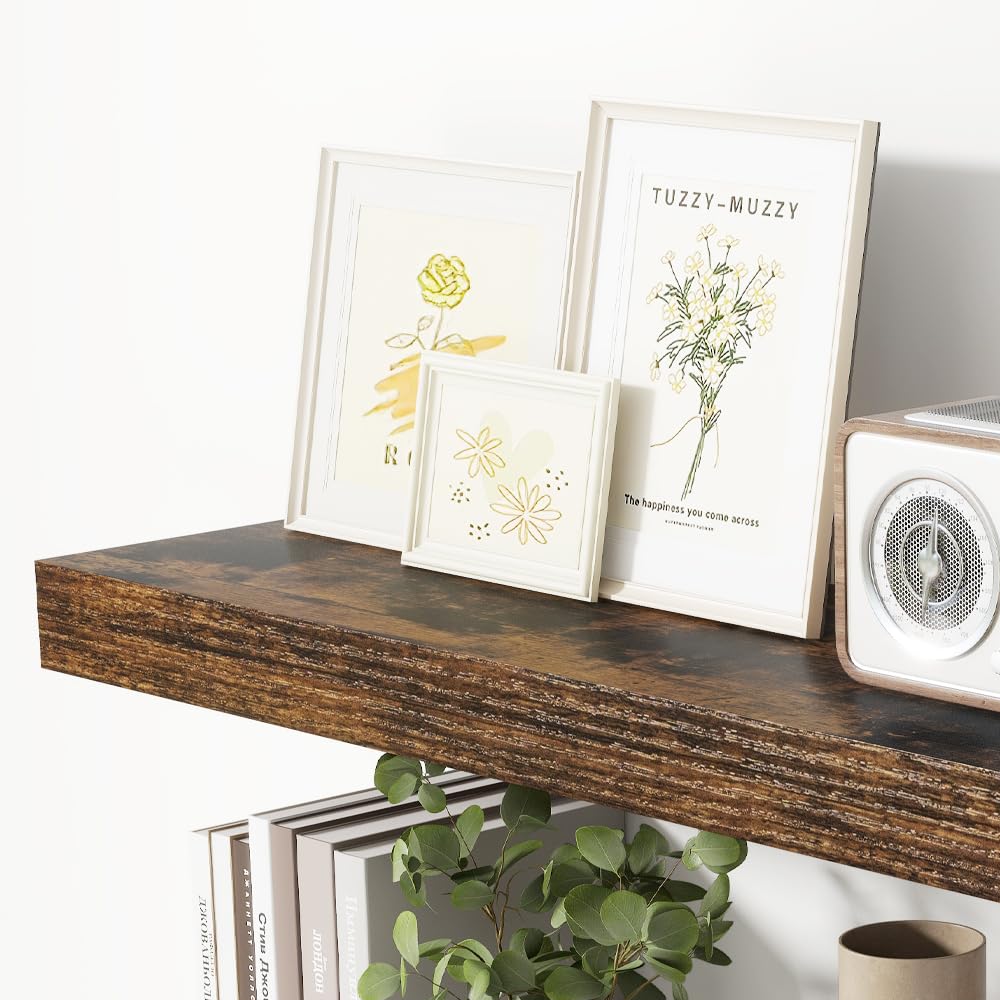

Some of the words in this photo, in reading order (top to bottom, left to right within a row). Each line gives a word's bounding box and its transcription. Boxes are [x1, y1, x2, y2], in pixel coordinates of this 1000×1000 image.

[652, 187, 799, 220] TUZZY-MUZZY
[624, 493, 640, 507] The
[642, 497, 685, 514] happiness
[687, 508, 703, 518] you
[705, 510, 729, 522] come
[731, 515, 760, 528] across
[243, 868, 254, 946] ДЖАННЕТТ
[258, 912, 268, 955] Стив
